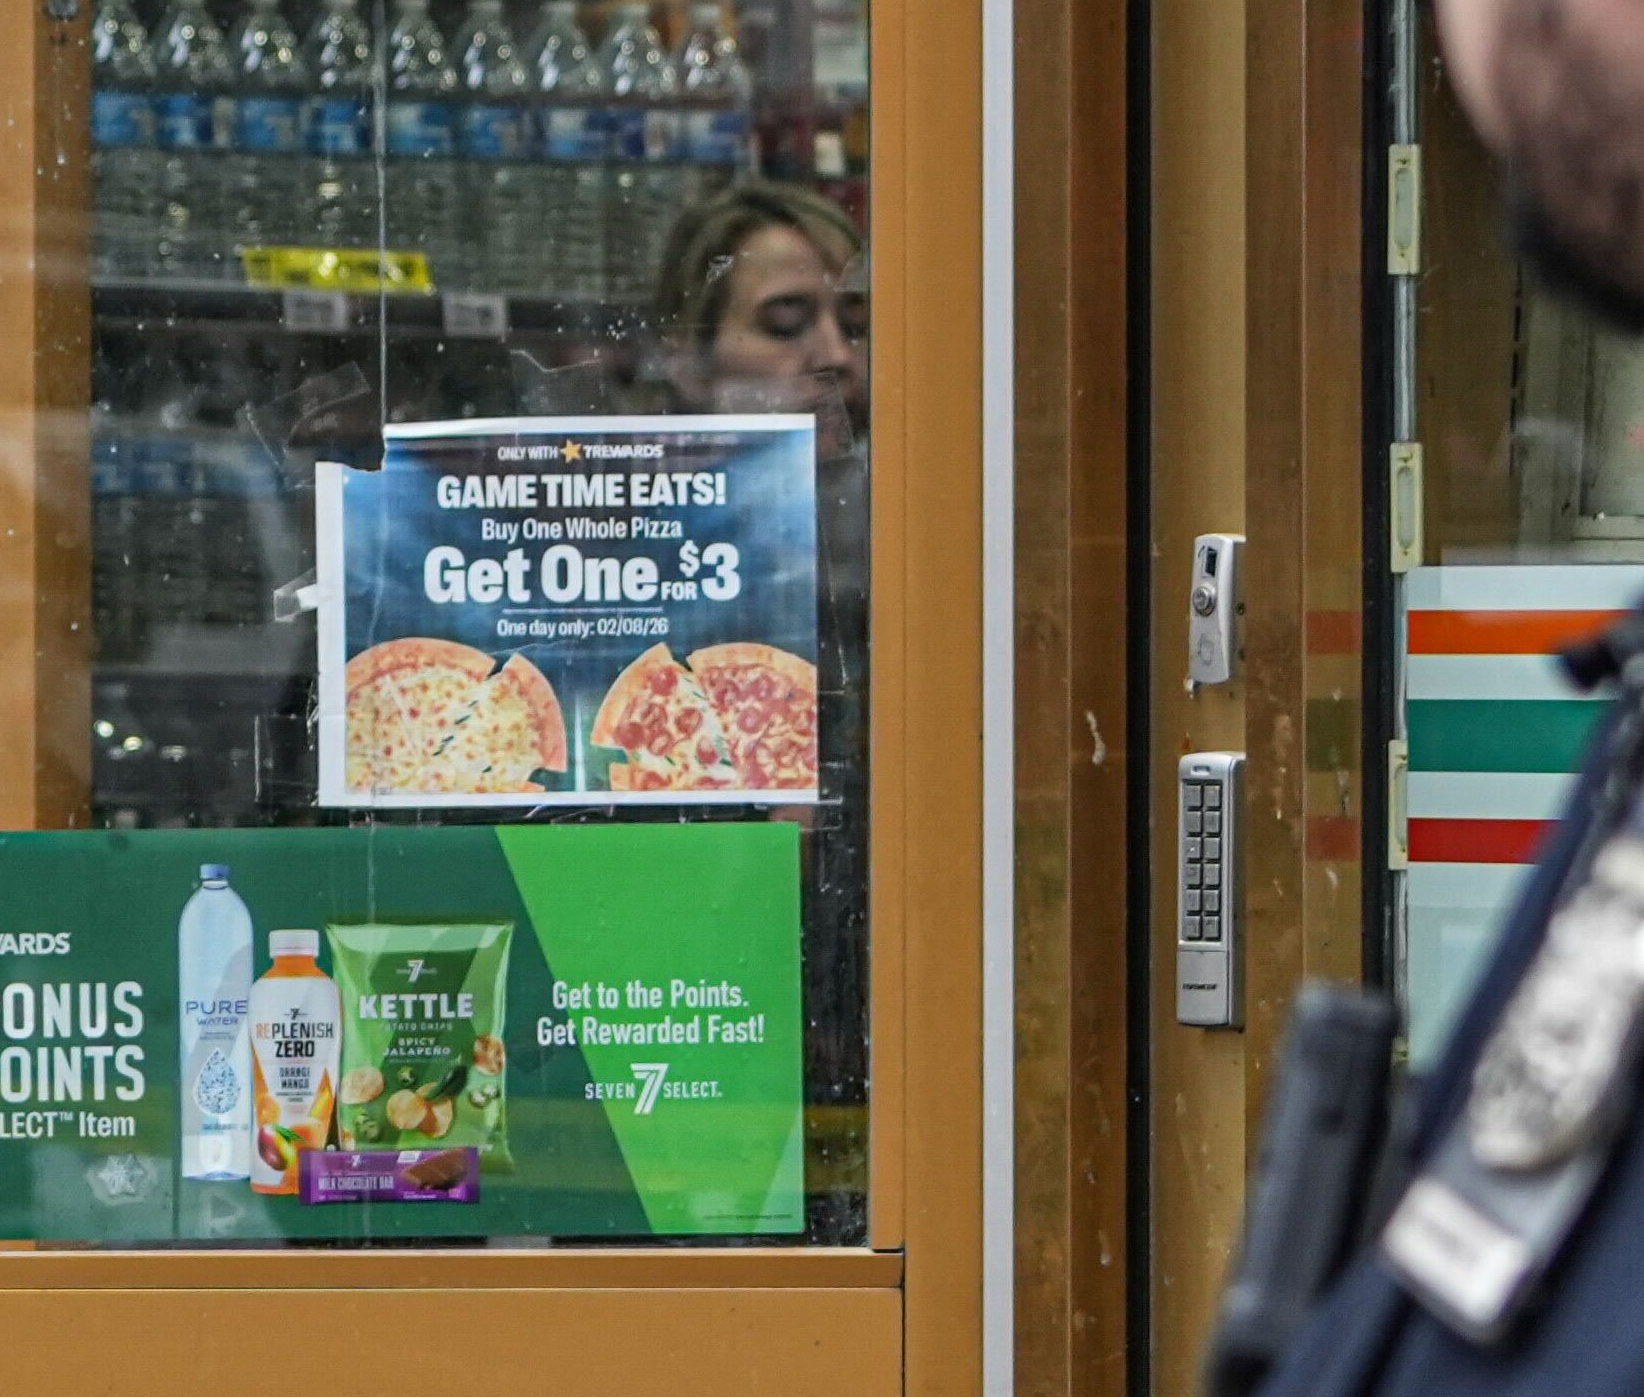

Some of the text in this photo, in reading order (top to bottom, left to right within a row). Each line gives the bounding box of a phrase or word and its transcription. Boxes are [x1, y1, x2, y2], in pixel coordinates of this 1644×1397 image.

[497, 445, 526, 463] ONLY
[527, 444, 559, 462] WITH
[437, 471, 727, 509] GAME TIME EATS!
[481, 516, 683, 544] Buy One Whole Pizza
[423, 544, 533, 604] Get
[541, 543, 659, 604] One
[661, 580, 698, 602] FOR
[496, 616, 670, 640] One day only: 02/08/26
[552, 979, 750, 1011] Get to the Points.
[185, 1000, 248, 1015] PURE
[359, 993, 474, 1020] KETTLE
[197, 1016, 239, 1026] WATER
[256, 1022, 334, 1040] REPLENISH
[420, 1020, 454, 1031] CHIPS
[536, 1013, 765, 1046] Get Rewarded Fast!
[275, 1040, 315, 1058] ZERO
[397, 1036, 437, 1047] SPICY
[279, 1067, 311, 1078] ORANGE
[281, 1079, 310, 1090] MANGO
[584, 1081, 636, 1100] SEVEN
[629, 1062, 670, 1116] 7
[78, 1111, 136, 1138] Item
